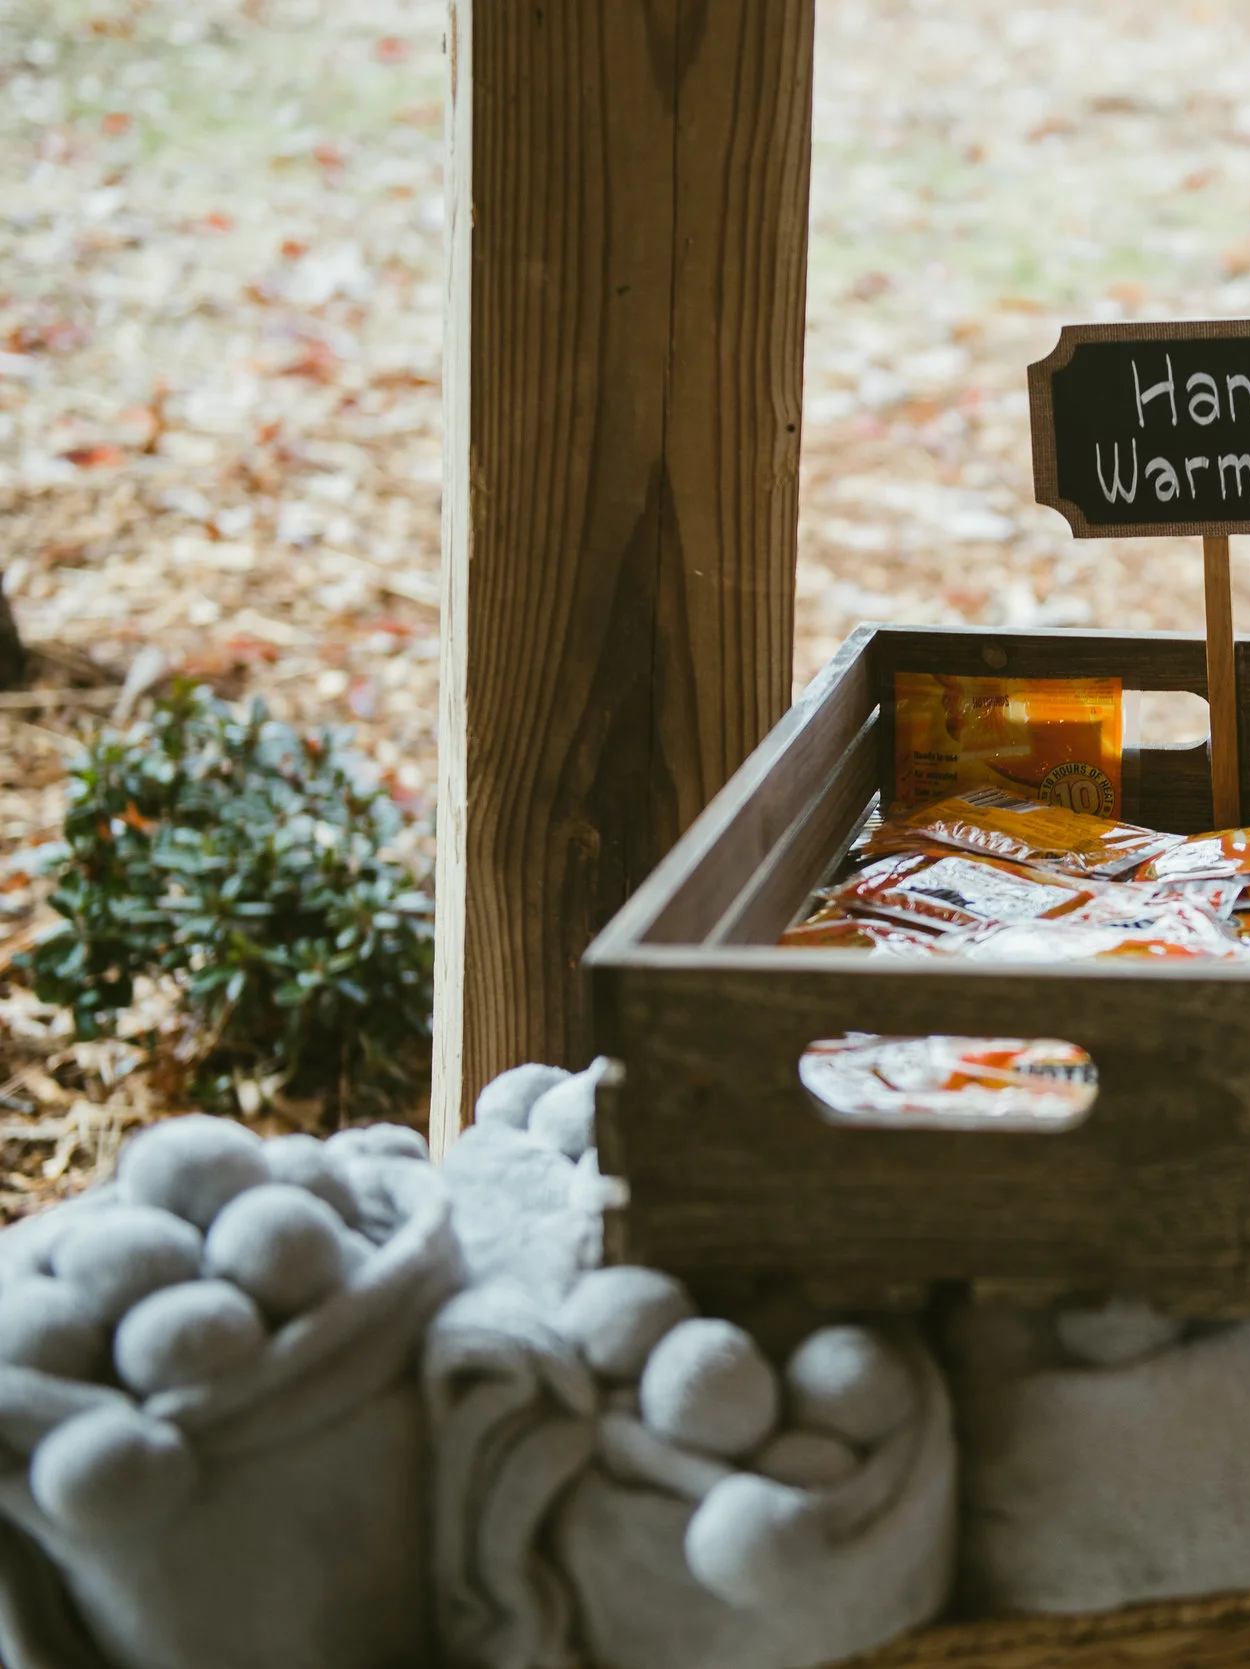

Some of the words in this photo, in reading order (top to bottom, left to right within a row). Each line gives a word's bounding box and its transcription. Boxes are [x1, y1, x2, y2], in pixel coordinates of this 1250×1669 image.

[1052, 763, 1087, 780] HOURS
[1089, 768, 1103, 780] OF
[1100, 779, 1114, 805] HEAT
[1054, 779, 1100, 816] 10
